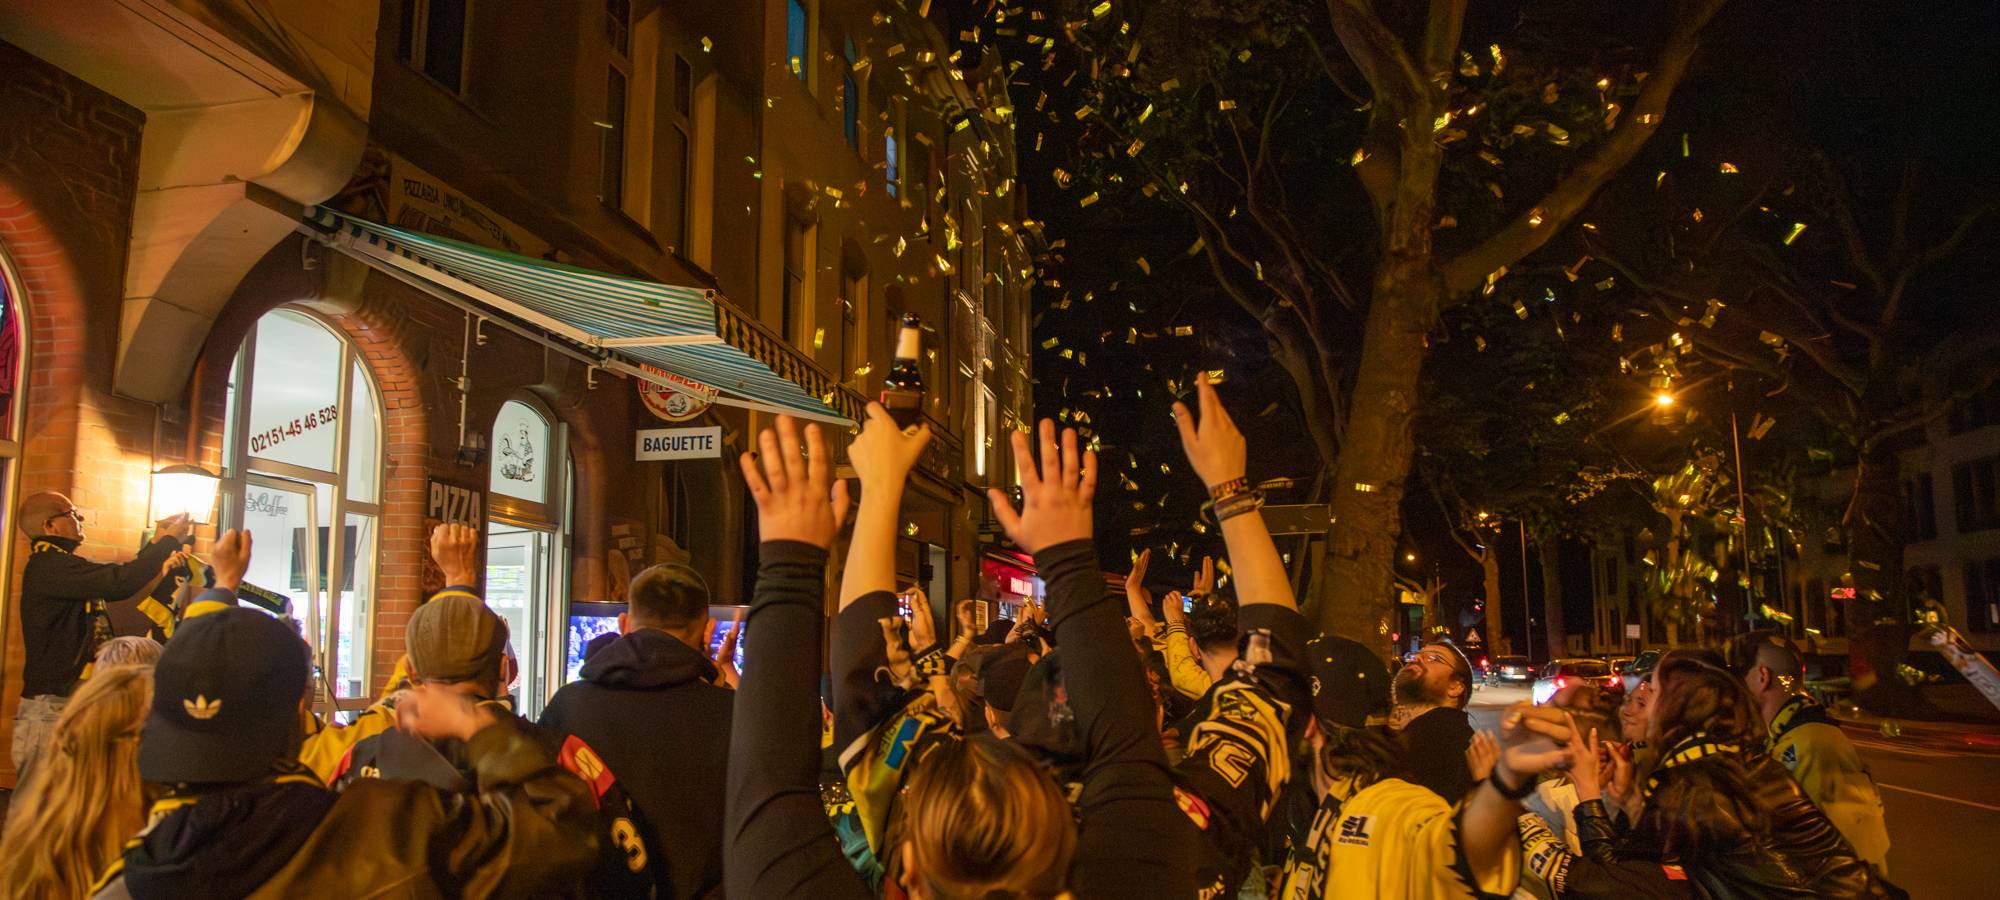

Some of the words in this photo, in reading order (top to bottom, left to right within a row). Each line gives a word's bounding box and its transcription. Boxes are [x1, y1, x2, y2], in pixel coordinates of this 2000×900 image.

[250, 419, 302, 454] 02151-45
[304, 412, 318, 431] 46
[318, 404, 338, 425] 528
[643, 435, 713, 452] BAGUETTE
[429, 481, 481, 531] PIZZA
[610, 816, 649, 874] 3
